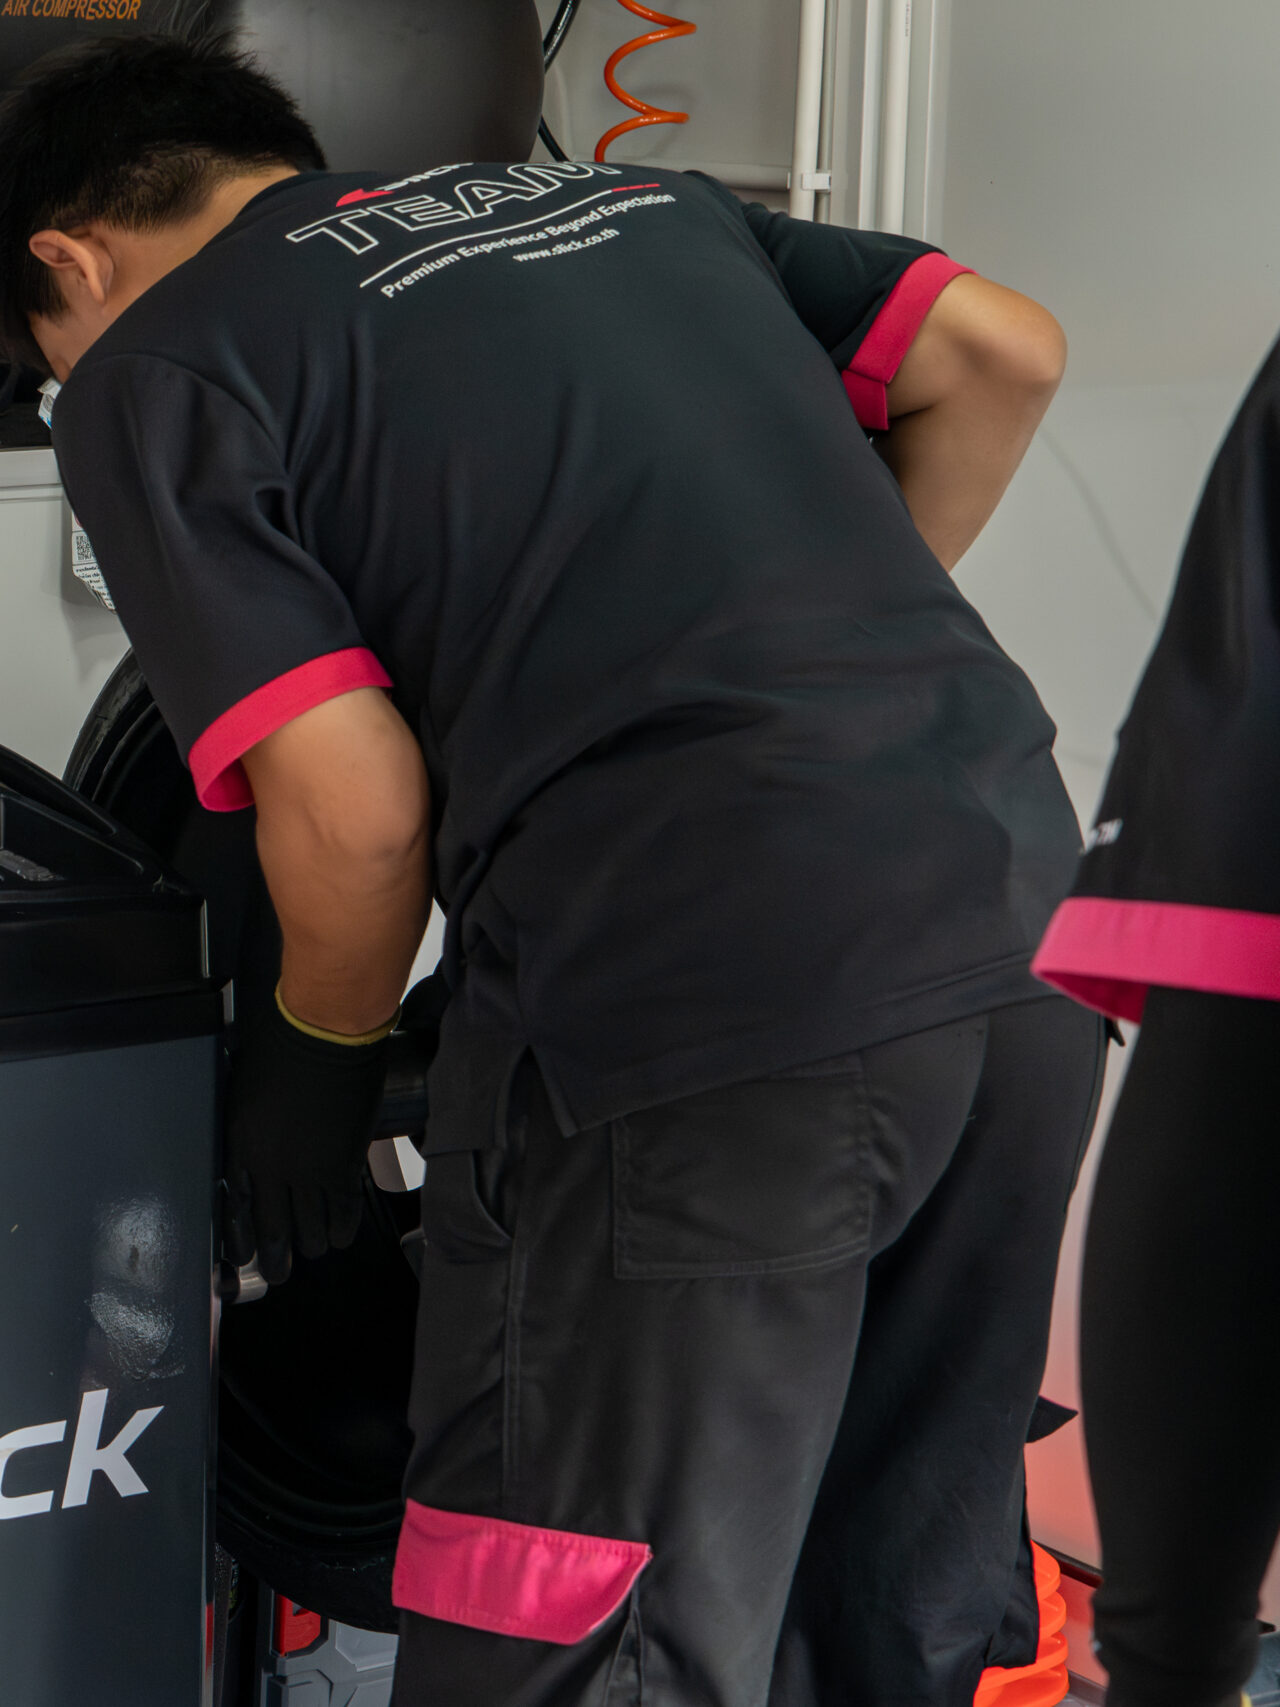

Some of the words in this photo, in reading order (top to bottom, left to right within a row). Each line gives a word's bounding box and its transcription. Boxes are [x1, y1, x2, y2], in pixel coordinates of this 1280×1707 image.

[1, 0, 30, 17] AIR
[31, 0, 142, 21] COMPRESSOR
[285, 160, 623, 256] TEAM
[380, 252, 461, 299] Premium
[456, 230, 550, 258] Experience
[544, 210, 603, 237] Beyond
[597, 192, 677, 218] Expectation
[512, 227, 621, 263] www.slick.co.th
